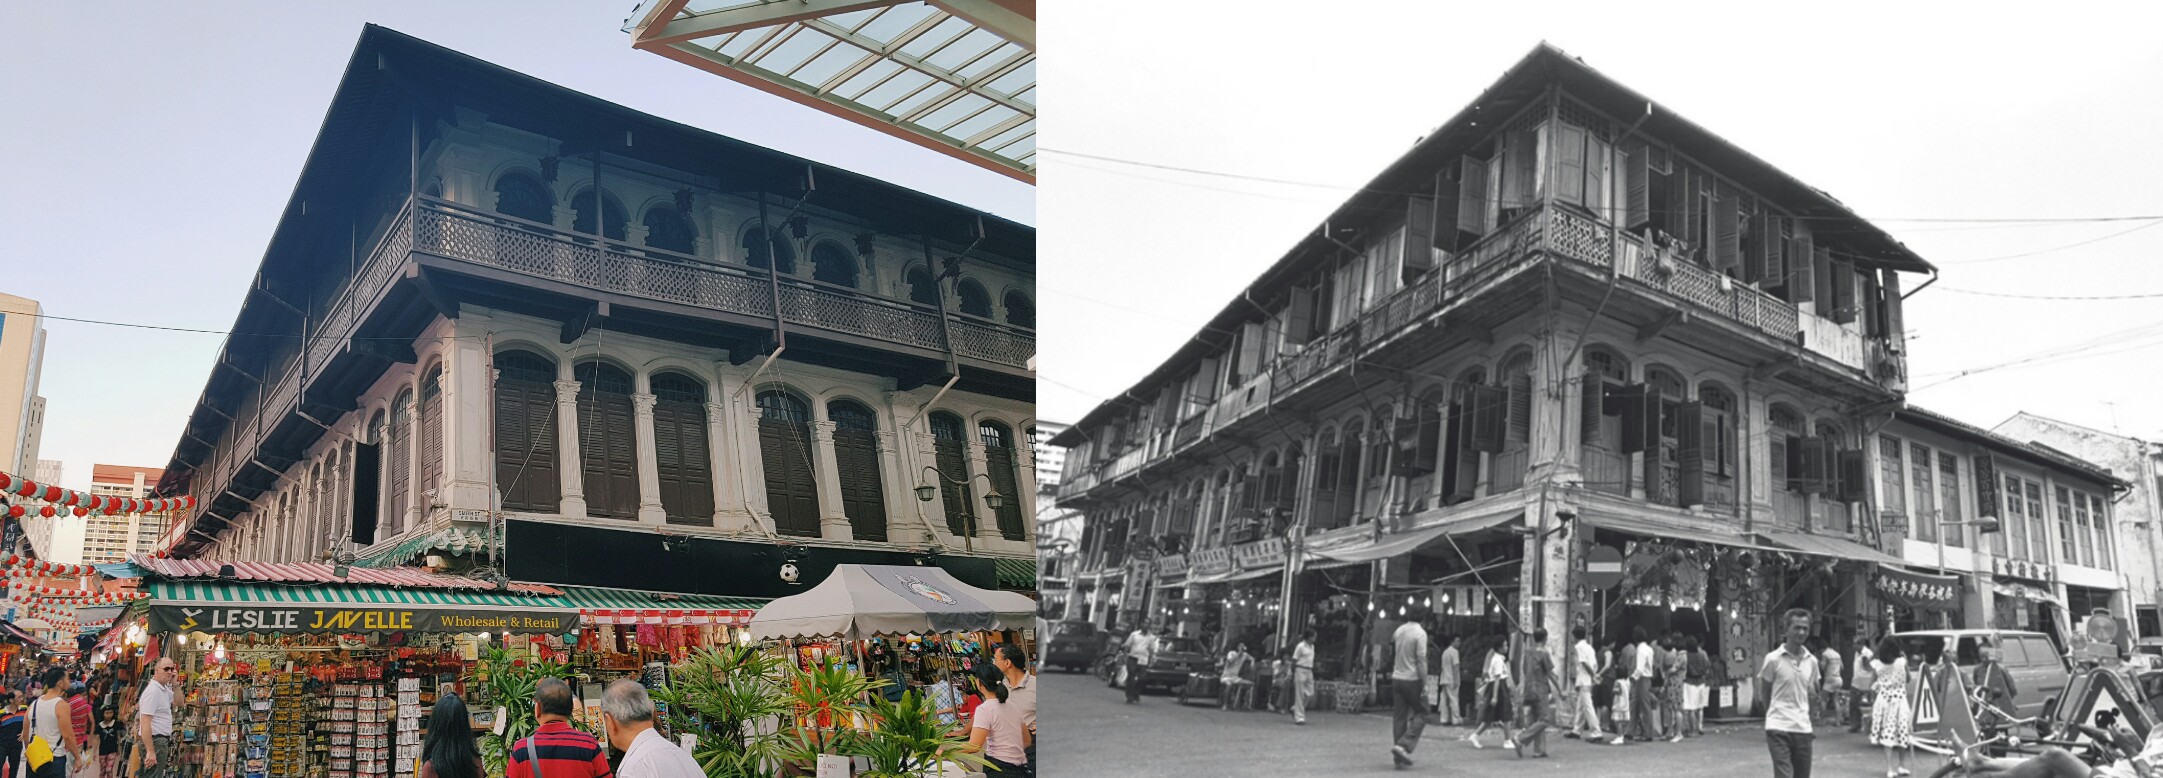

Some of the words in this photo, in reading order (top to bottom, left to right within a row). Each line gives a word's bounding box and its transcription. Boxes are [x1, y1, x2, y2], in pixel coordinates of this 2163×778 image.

[211, 609, 300, 629] LESLIE
[309, 610, 413, 629] JAVELLE
[440, 615, 507, 628] Wholesale
[510, 616, 520, 628] &
[524, 617, 560, 629] Retail
